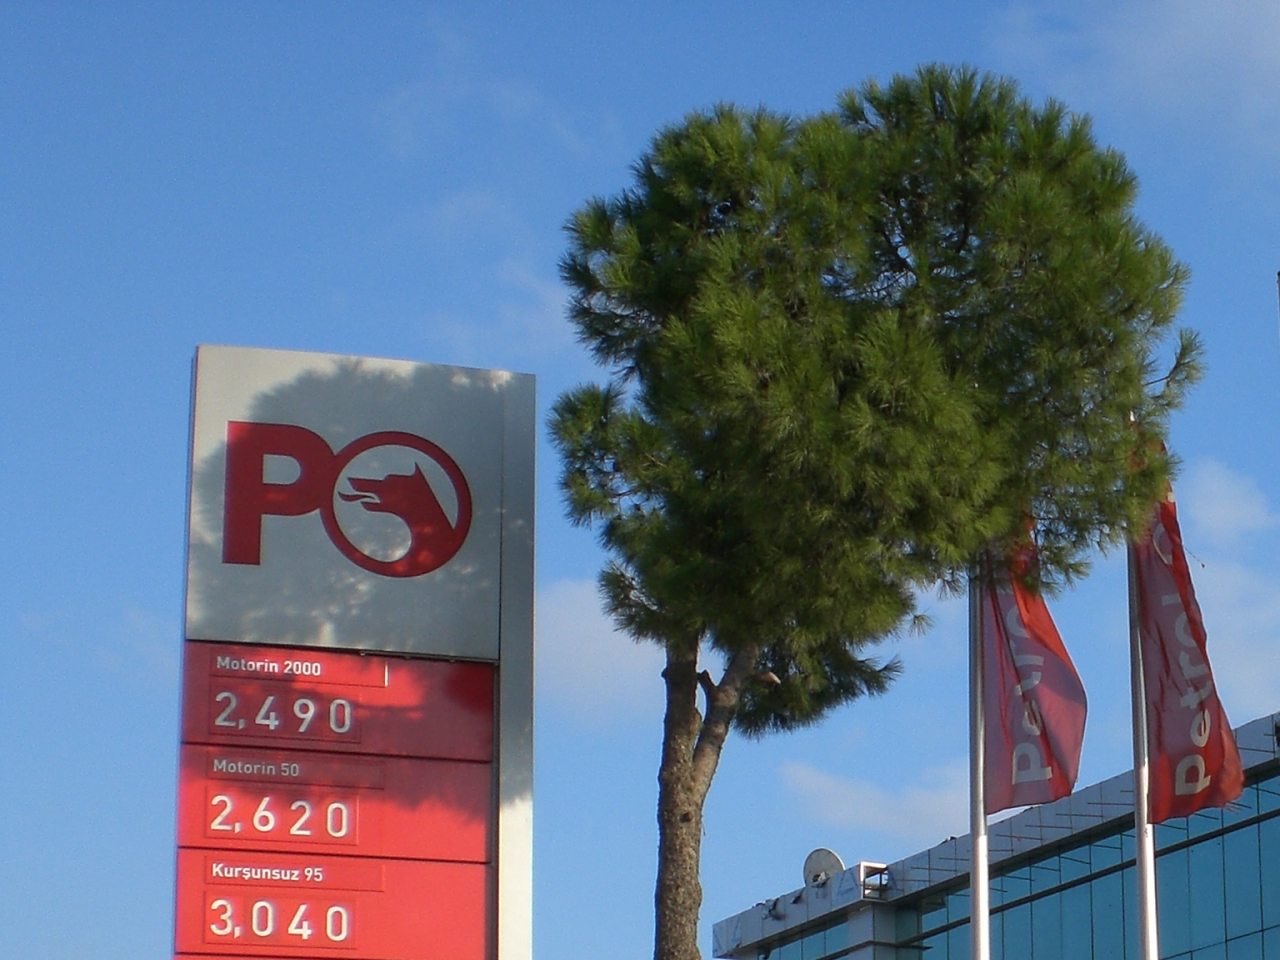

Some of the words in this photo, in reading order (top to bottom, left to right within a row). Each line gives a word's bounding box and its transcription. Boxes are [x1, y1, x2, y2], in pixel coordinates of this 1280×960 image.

[216, 656, 279, 673] Motorin
[283, 660, 322, 676] 2000
[214, 691, 352, 733] 2,490
[213, 758, 276, 775] Motorin
[281, 763, 300, 777] 50
[210, 794, 348, 838] 2,620
[212, 863, 300, 880] Kurşunsuz
[304, 867, 323, 882] 95
[210, 899, 348, 942] 3,040
